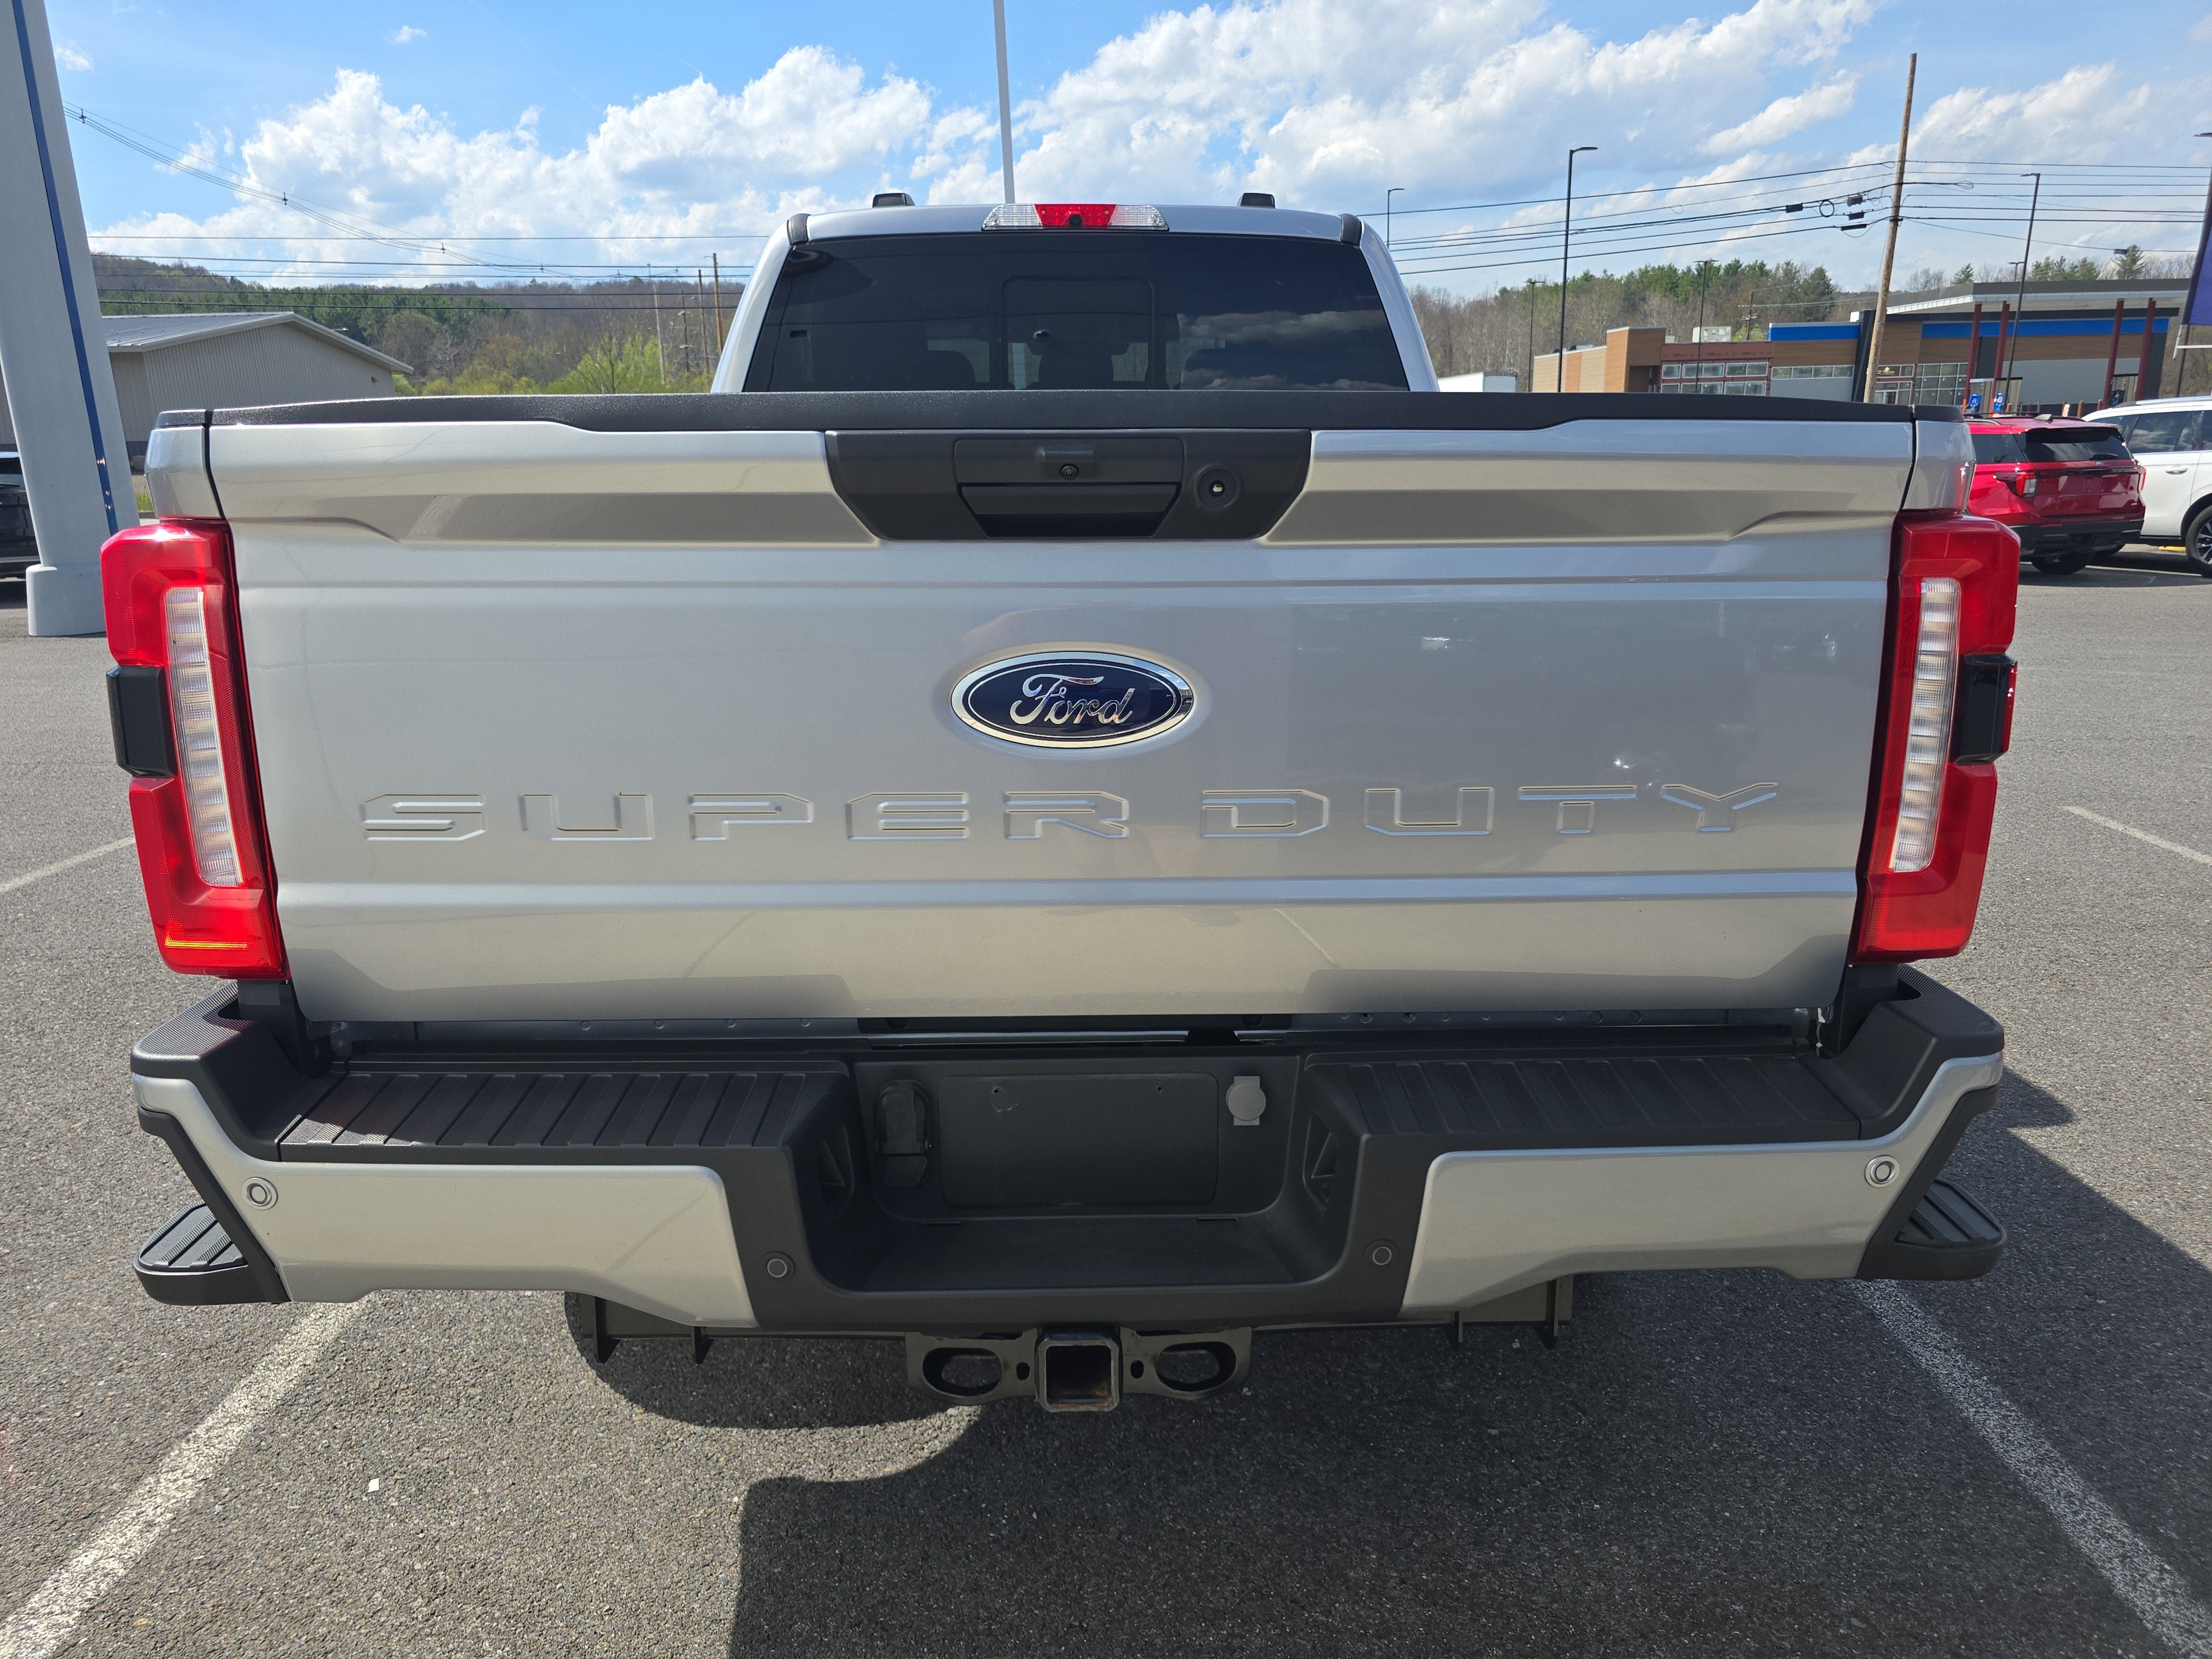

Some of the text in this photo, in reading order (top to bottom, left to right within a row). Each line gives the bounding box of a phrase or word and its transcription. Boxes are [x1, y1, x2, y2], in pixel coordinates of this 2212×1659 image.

[1009, 673, 1135, 725] Ford
[359, 781, 1779, 842] SUPER DUTY
